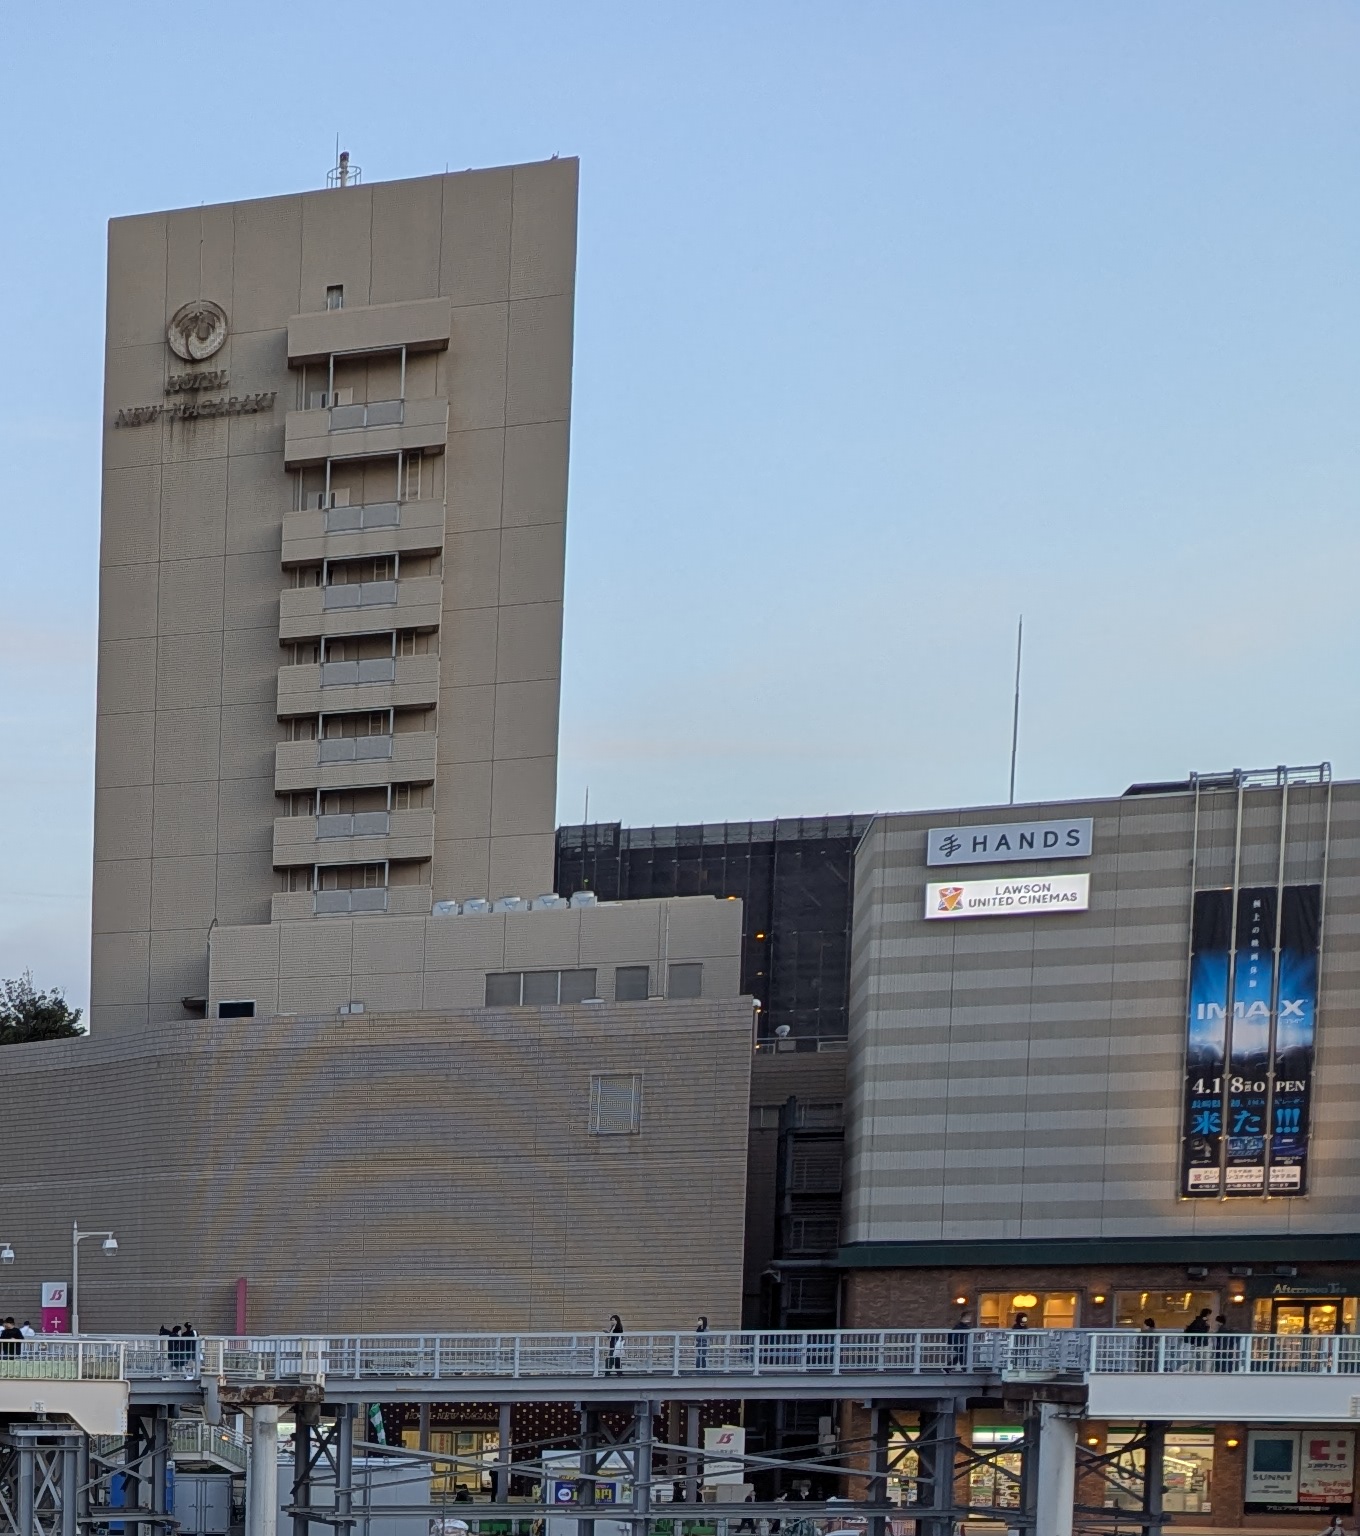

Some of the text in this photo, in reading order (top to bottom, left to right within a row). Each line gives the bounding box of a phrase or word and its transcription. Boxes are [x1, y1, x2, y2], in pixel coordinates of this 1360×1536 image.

[165, 370, 229, 396] HOTEL
[114, 404, 164, 429] NEW
[972, 829, 1081, 853] HANDS
[995, 883, 1051, 896] LAWSON
[968, 892, 1077, 908] UNITED CINEMAS
[1197, 999, 1305, 1020] IMAX
[1192, 1077, 1306, 1094] 4.18 OPEN
[437, 1412, 459, 1420] NEW
